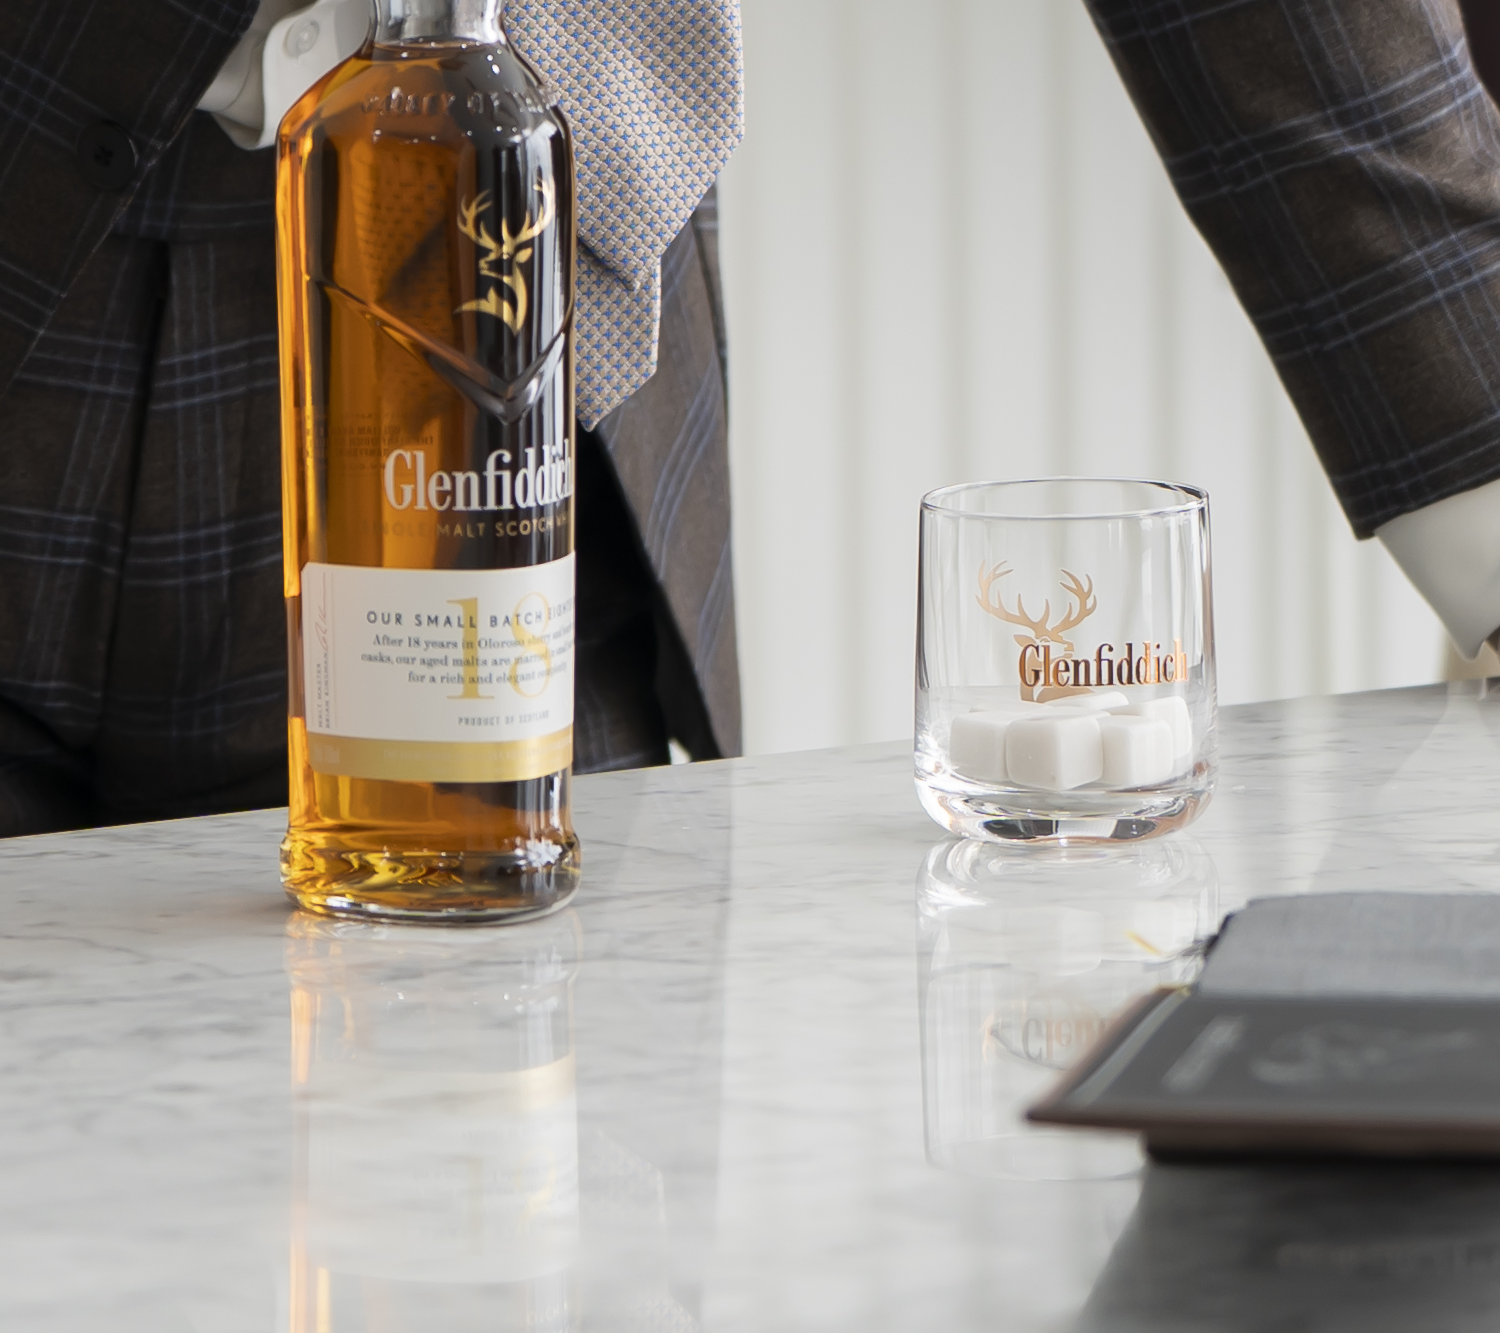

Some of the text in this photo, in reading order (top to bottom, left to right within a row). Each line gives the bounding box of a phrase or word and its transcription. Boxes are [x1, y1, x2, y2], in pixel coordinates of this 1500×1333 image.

[384, 438, 573, 511] Glenfiddich
[437, 522, 485, 538] MALT
[495, 516, 553, 537] SCOTCH
[366, 610, 403, 626] OUR
[414, 614, 477, 628] SMALL
[489, 611, 543, 628] BATCH
[373, 634, 403, 647] After
[407, 635, 421, 647] 18
[424, 638, 459, 651] years
[461, 637, 475, 649] in
[446, 591, 553, 700] 18
[396, 655, 417, 665] our
[419, 654, 448, 667] aged
[452, 655, 488, 667] malts
[491, 656, 511, 666] are
[1018, 638, 1188, 688] Glenfiddich
[408, 671, 426, 683] for
[428, 674, 436, 683] a
[440, 672, 464, 684] rich
[468, 672, 493, 684] and
[458, 716, 500, 726] PRODUCT
